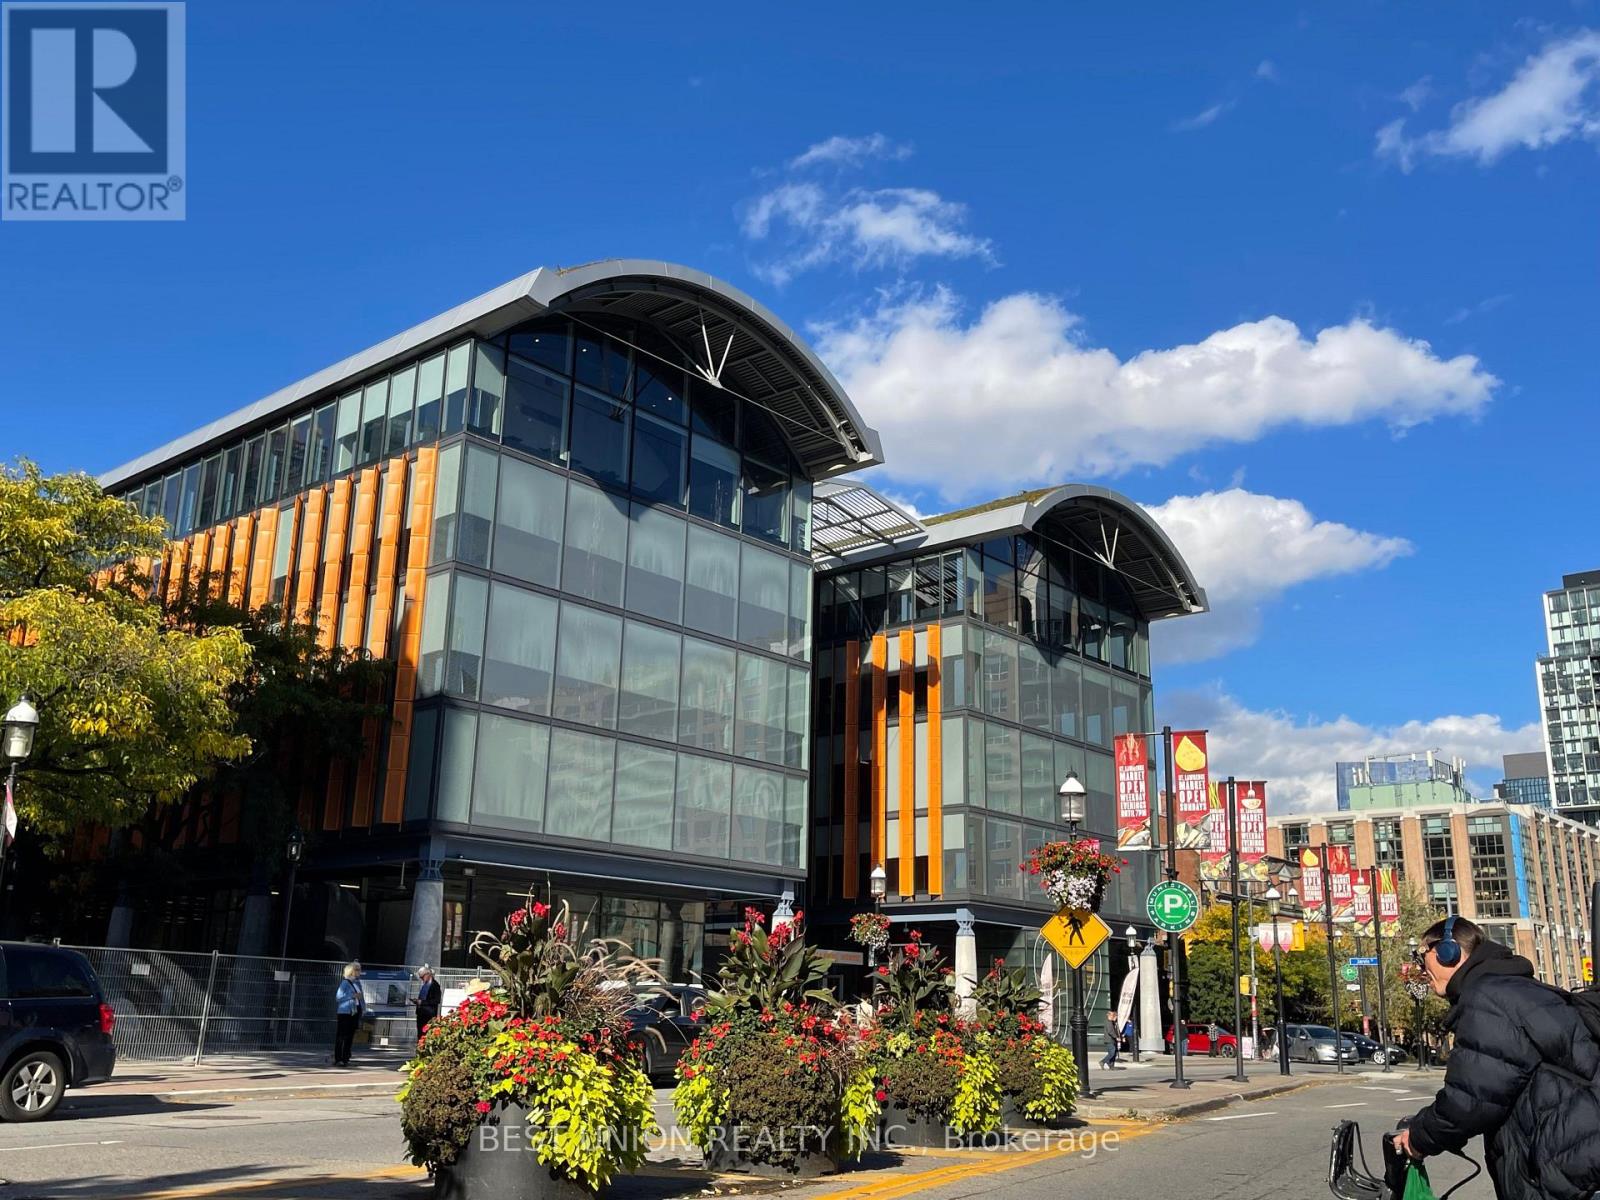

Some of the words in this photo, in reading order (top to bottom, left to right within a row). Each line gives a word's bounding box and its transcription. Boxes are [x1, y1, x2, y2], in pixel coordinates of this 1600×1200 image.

[1119, 771, 1145, 781] MARKET
[1120, 781, 1146, 793] OPEN
[1179, 780, 1206, 790] MARKET
[1120, 793, 1146, 802] WEEKDAY
[1179, 790, 1207, 803] OPEN
[1180, 802, 1207, 811] SUNDAYS
[1241, 821, 1264, 833] OPEN
[1164, 894, 1183, 914] P
[1150, 910, 1196, 930] PARKING
